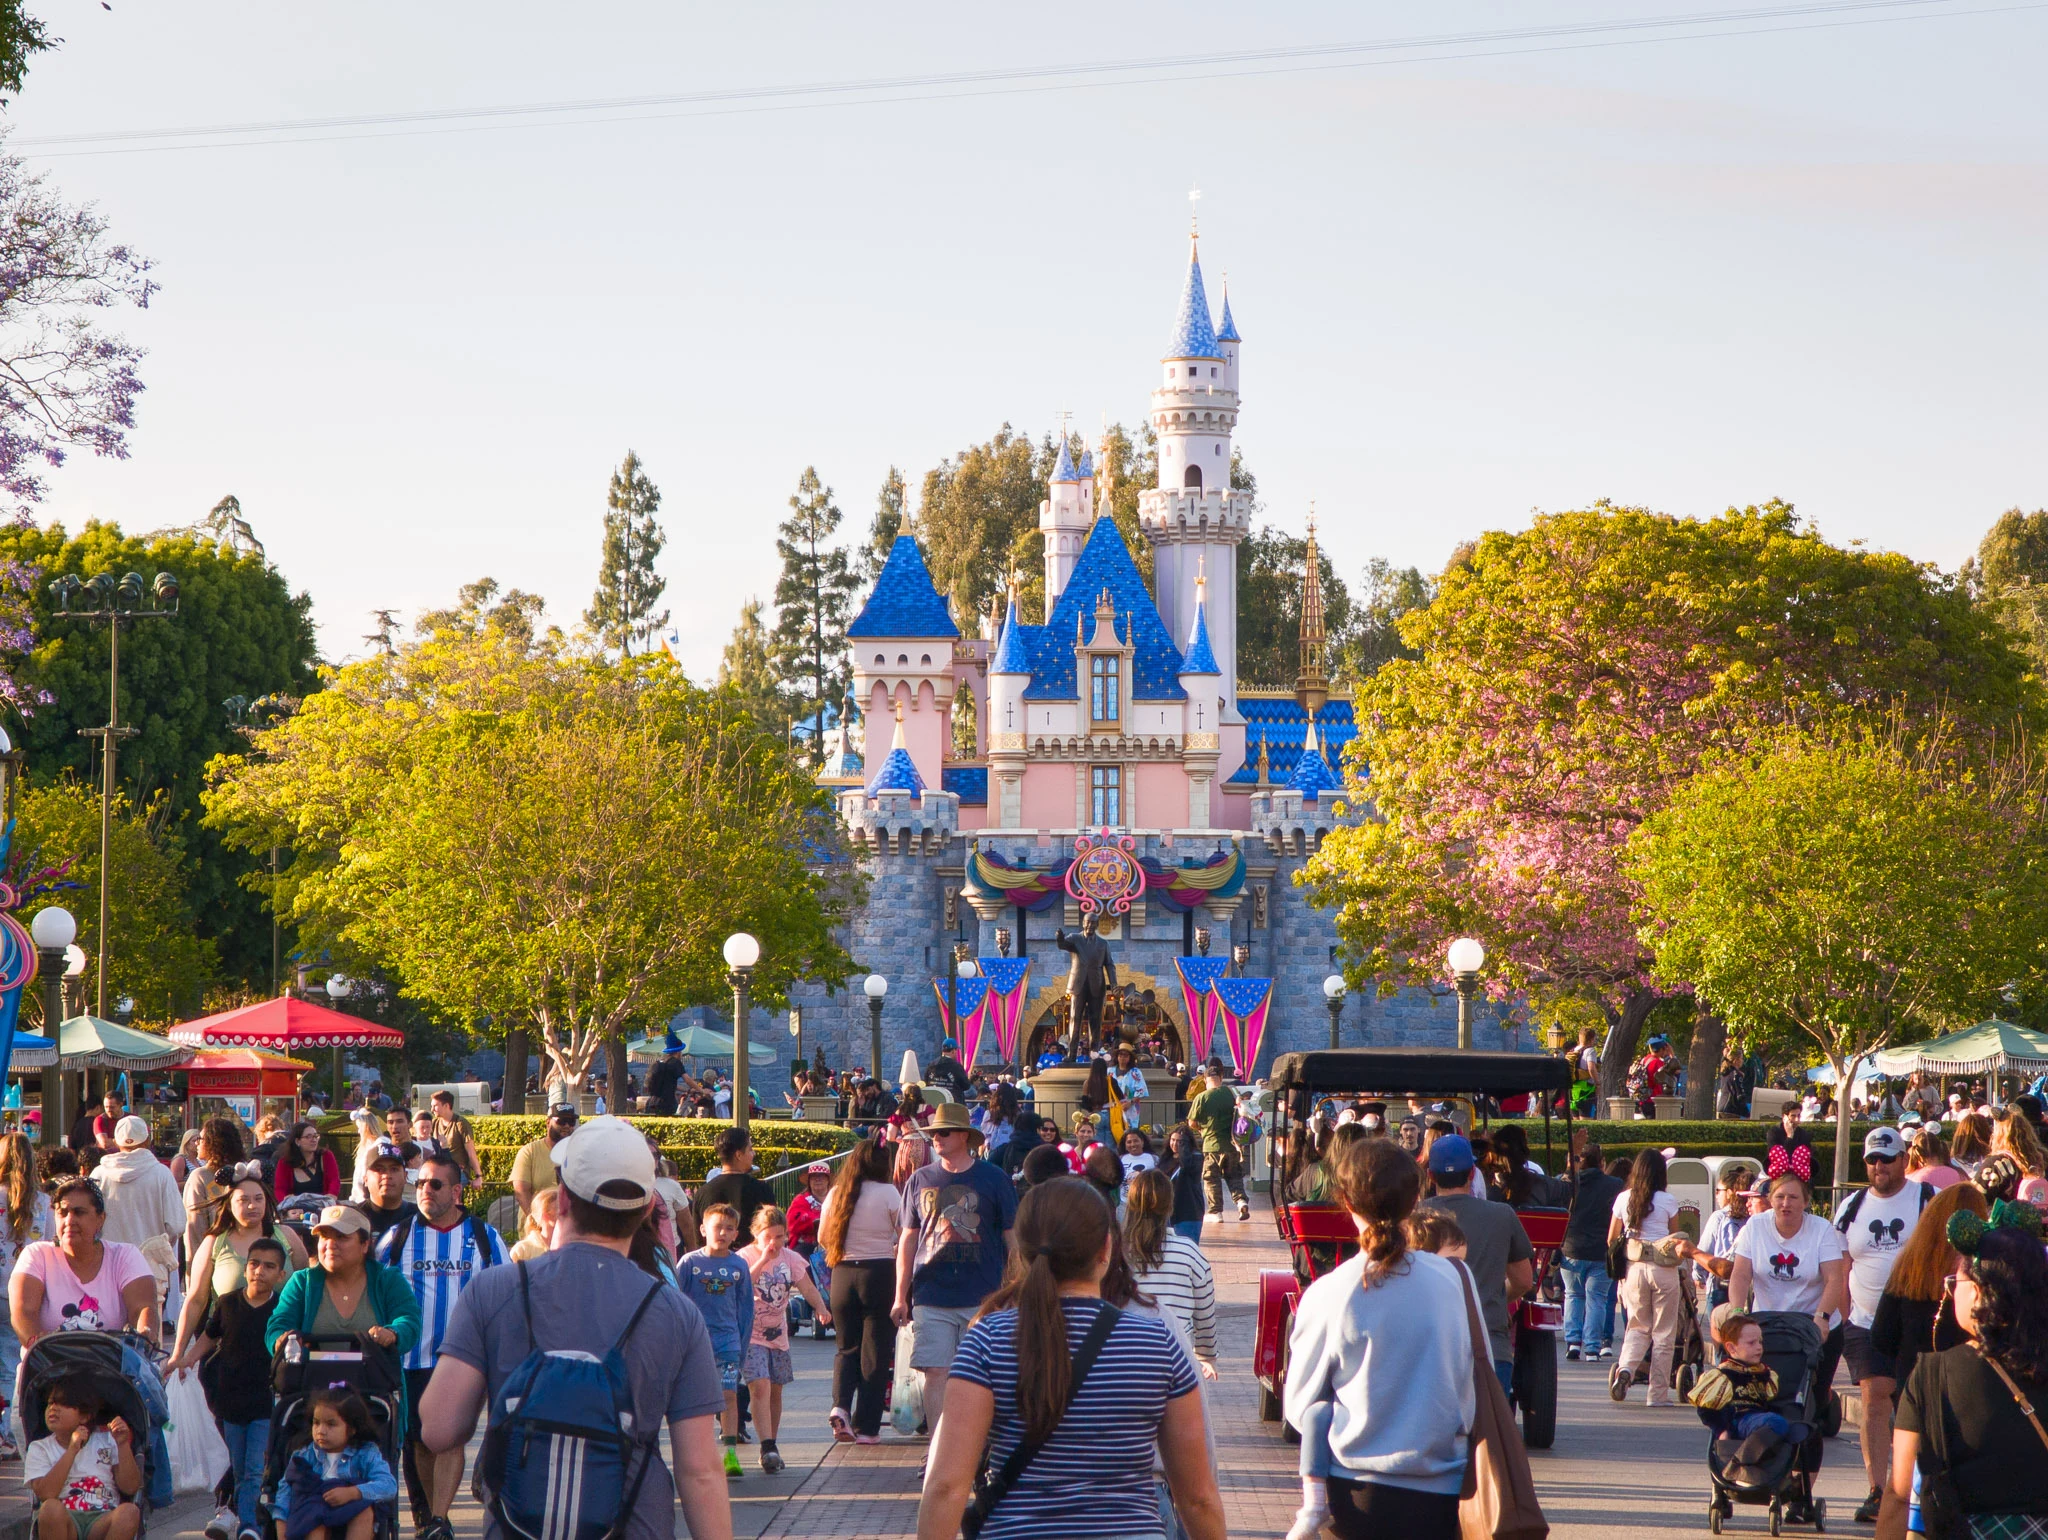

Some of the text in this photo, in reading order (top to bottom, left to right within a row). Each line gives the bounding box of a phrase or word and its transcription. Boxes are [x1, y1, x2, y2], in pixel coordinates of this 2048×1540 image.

[1088, 862, 1123, 884] 70
[195, 1074, 255, 1086] POPCORN
[412, 1260, 473, 1271] OSWALD
